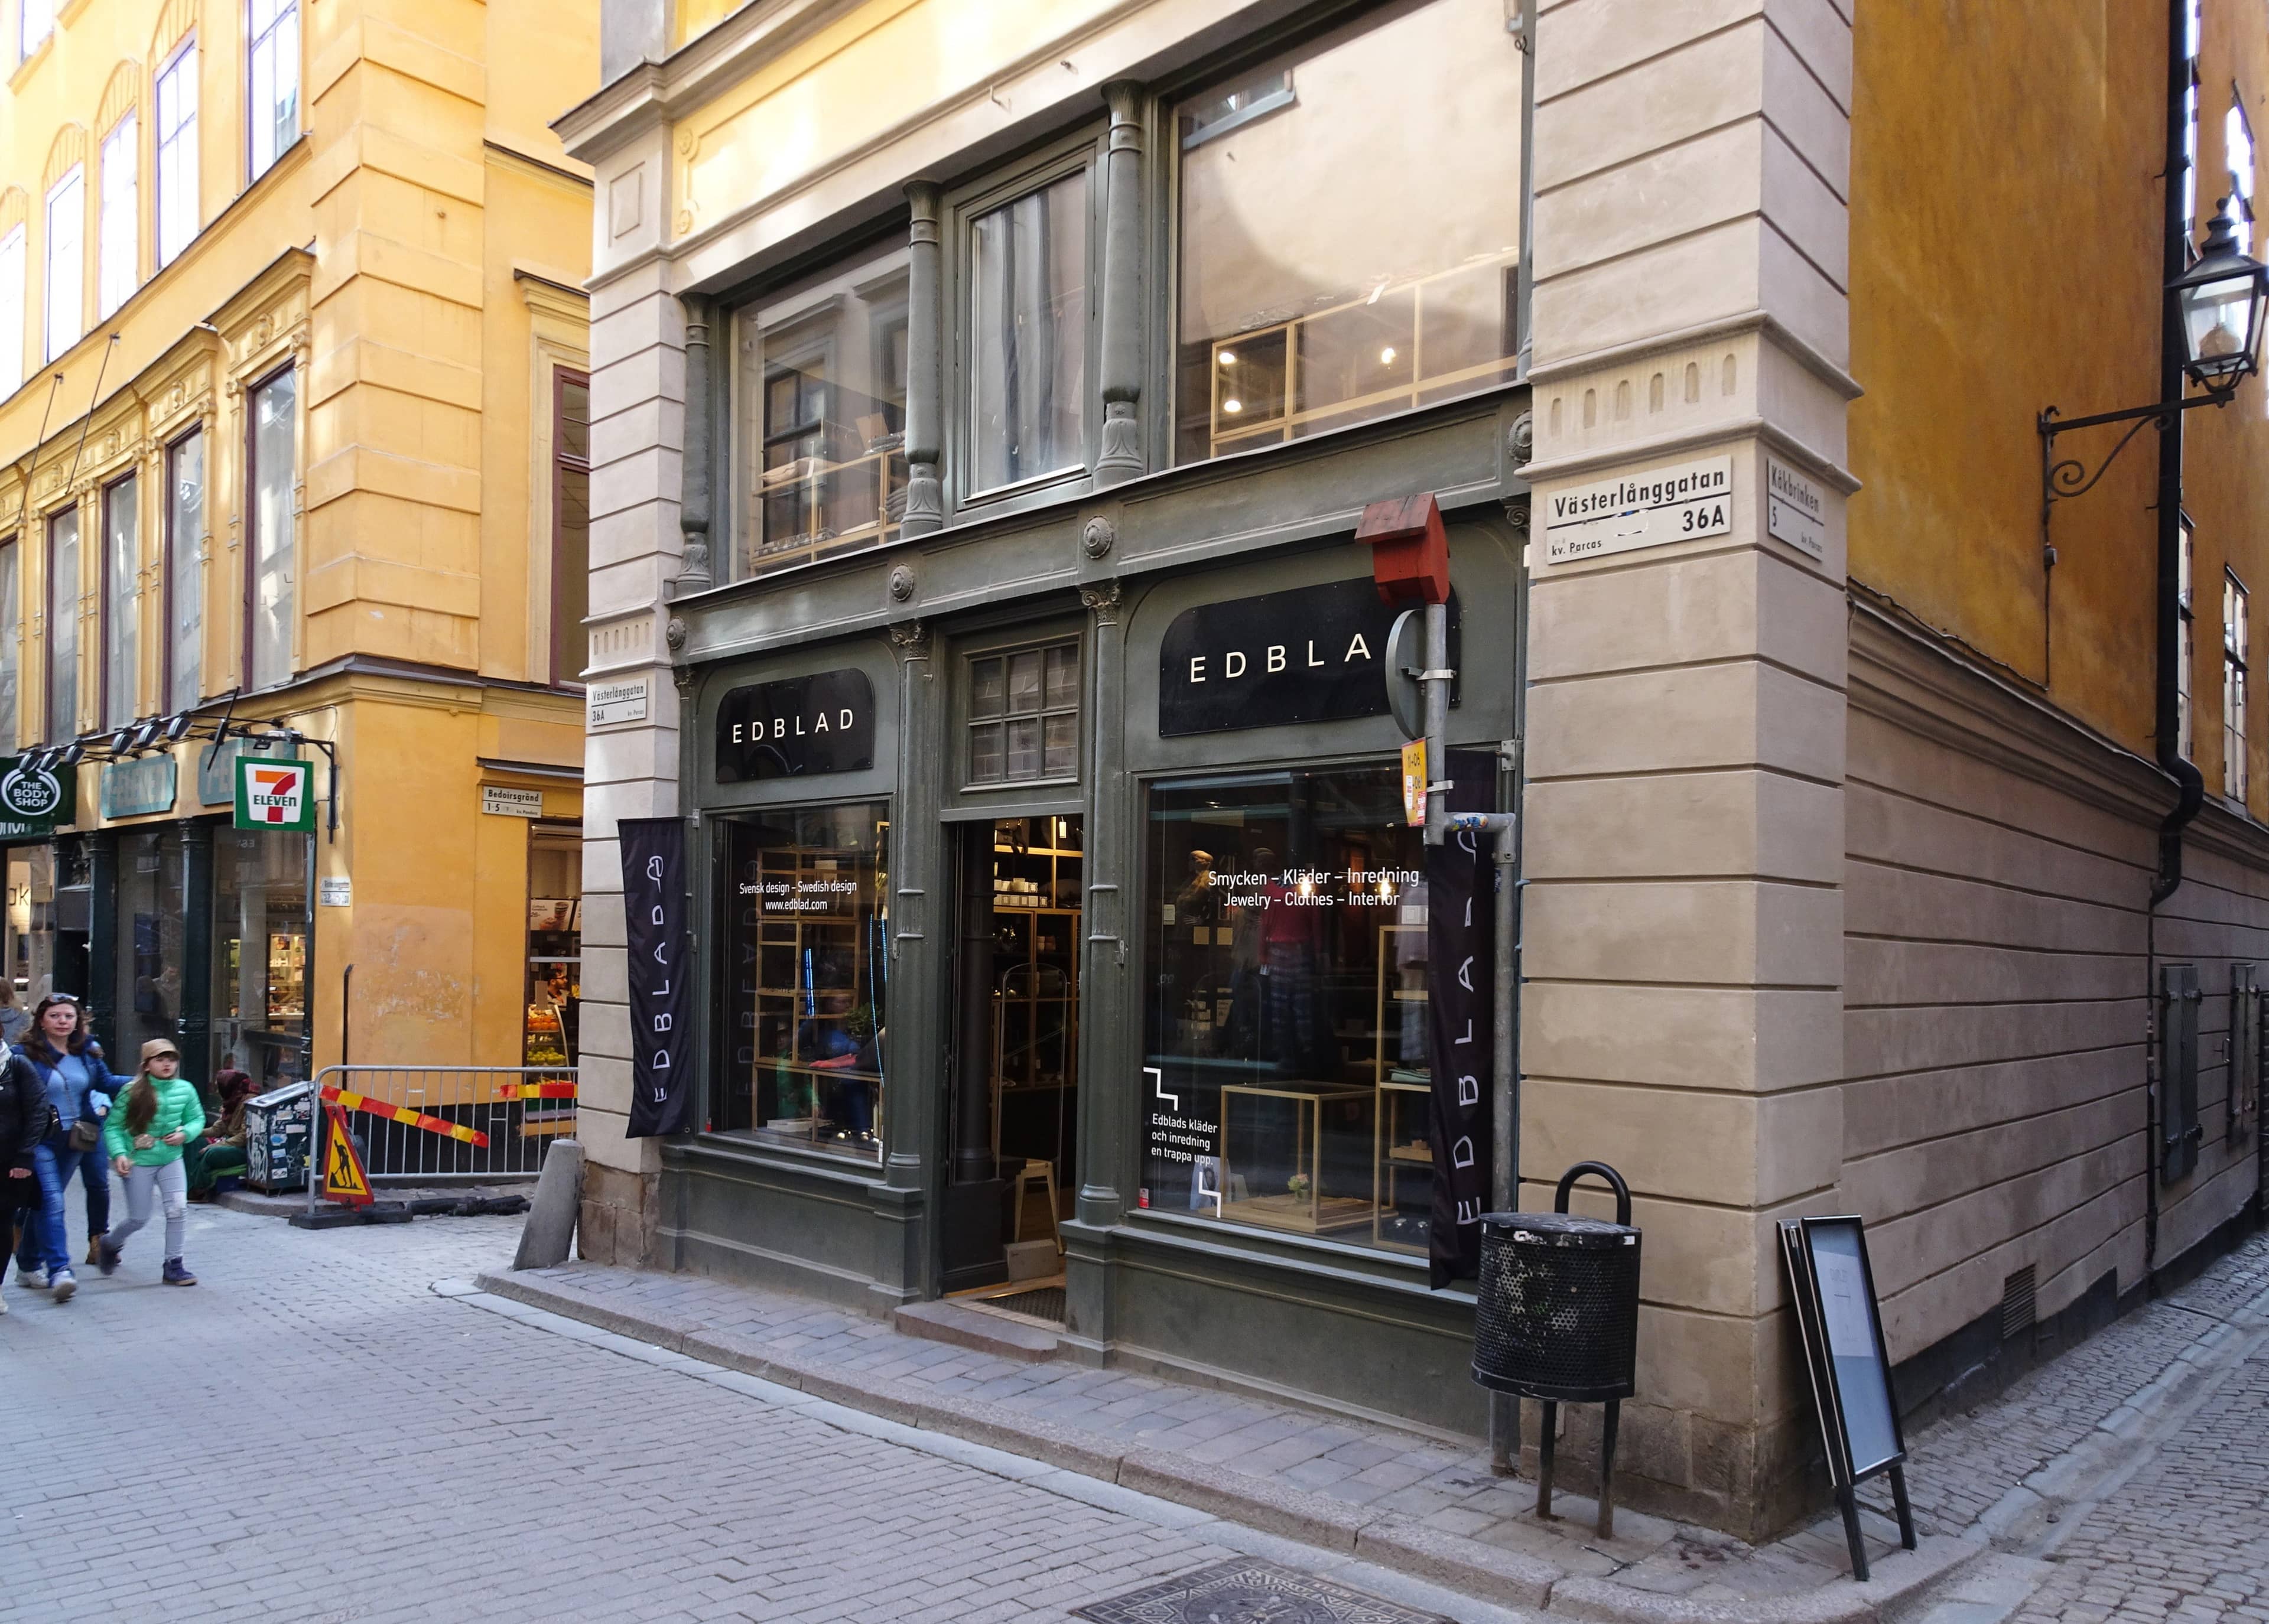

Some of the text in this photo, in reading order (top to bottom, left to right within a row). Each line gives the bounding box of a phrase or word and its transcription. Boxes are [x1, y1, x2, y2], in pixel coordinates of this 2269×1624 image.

[1555, 471, 1724, 518] Västerlånggatan
[1772, 465, 1819, 513] Kåkbrinken
[1682, 505, 1724, 532] 36A
[1773, 506, 1777, 527] 5
[1552, 539, 1602, 556] kv. Parcas
[1190, 633, 1371, 684] EDBLA
[593, 685, 643, 701] Västerlånggatan
[593, 710, 604, 721] 36A
[733, 708, 853, 743] EDBLAD
[13, 789, 50, 799] BODY
[21, 782, 42, 790] THE
[488, 789, 539, 802] Bedoirsgränd
[15, 798, 48, 807] SHOP
[739, 883, 765, 894] Svensk
[766, 881, 790, 896] design
[798, 880, 829, 893] Swedish
[831, 880, 857, 894] design
[1208, 870, 1267, 890] Smycken
[1283, 868, 1331, 885] Kläder
[1347, 867, 1419, 887] Inredning
[765, 898, 827, 910] www.edblad.com
[1224, 892, 1271, 910] Jewelry
[1285, 891, 1333, 906] Clothes
[1348, 891, 1400, 906] Interior
[652, 904, 672, 1103] EDBLAD
[1152, 1113, 1218, 1134] Edblads kläder
[1152, 1130, 1210, 1151] och inredning
[1151, 1147, 1213, 1167] en trappa upp.
